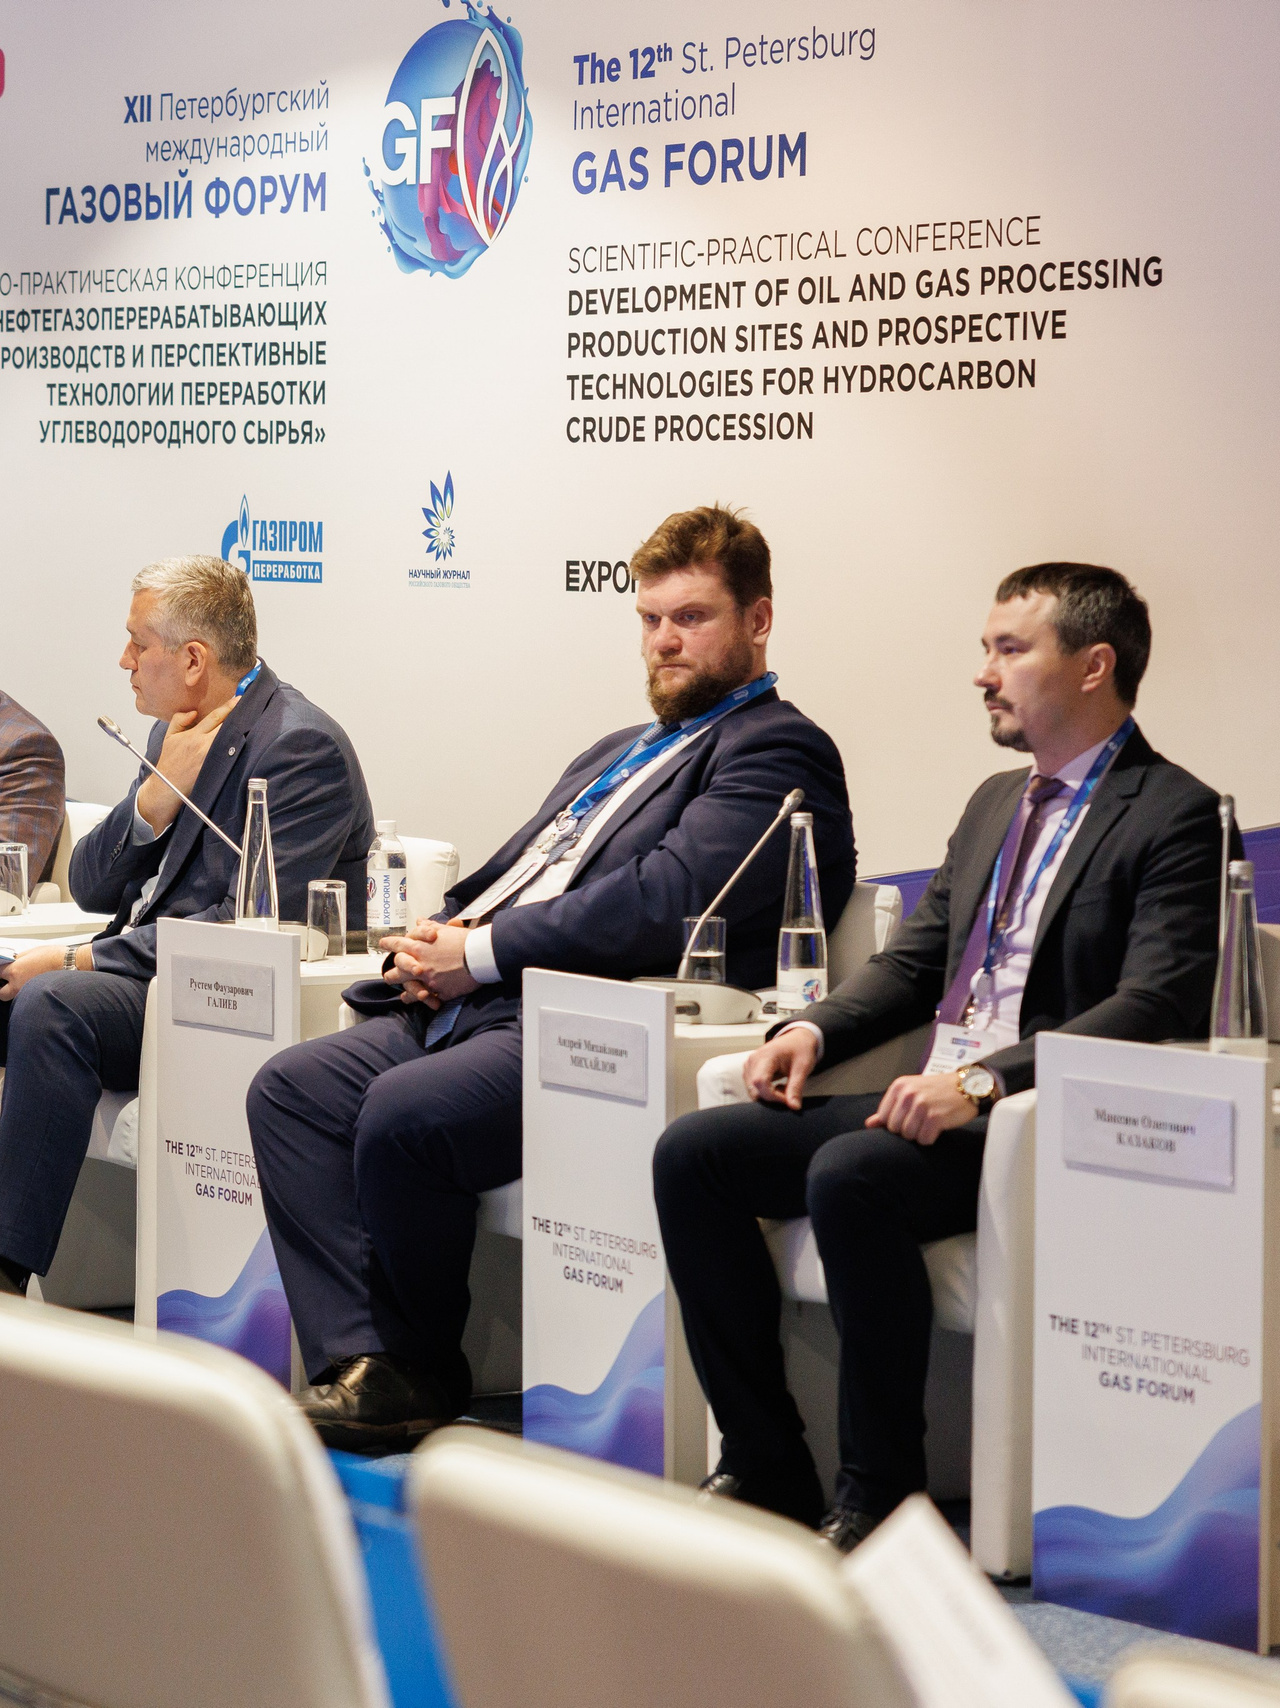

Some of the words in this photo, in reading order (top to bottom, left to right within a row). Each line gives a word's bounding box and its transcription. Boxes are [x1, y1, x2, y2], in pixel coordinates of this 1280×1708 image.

[573, 53, 622, 86] The
[630, 44, 672, 80] 12th
[682, 40, 715, 75] St.
[725, 25, 877, 70] Petersburg
[123, 94, 152, 124] XII
[159, 80, 330, 124] Петербургский
[573, 82, 736, 131] International
[145, 122, 329, 165] международный
[572, 145, 649, 195] GAS
[664, 132, 808, 189] FORUM
[45, 171, 193, 226] ГАЗОВЫЙ
[204, 171, 327, 219] ФОРУМ
[569, 231, 846, 274] SCIENTIFIC-PRACTICAL
[858, 215, 1042, 256] CONFERENCE
[175, 261, 327, 293] КОНФЕРЕНЦИЯ
[568, 283, 746, 316] DEVELOPMENT
[754, 278, 789, 308] OF
[798, 276, 841, 306] OIL
[848, 271, 906, 302] AND
[916, 267, 970, 298] GAS
[980, 256, 1163, 294] PROCESSING
[567, 325, 725, 359] PRODUCTION
[735, 320, 803, 352] SITES
[812, 318, 868, 350] AND
[879, 310, 1067, 347] PROSPECTIVE
[133, 344, 145, 368] И
[151, 341, 327, 367] ПЕРСПЕКТИВНЫЕ
[46, 382, 174, 407] ТЕХНОЛОГИИ
[181, 380, 327, 406] ПЕРЕРАБОТКИ
[566, 368, 754, 402] TECHNOLOGIES
[763, 365, 814, 397] FOR
[823, 358, 1036, 394] HYDROCARBON
[39, 420, 236, 448] УГЛЕВОДОРОДНОГО
[243, 419, 326, 444] СЫРЬЯ»
[566, 413, 644, 444] CRUDE
[654, 410, 814, 442] PROCESSION
[252, 519, 323, 553] ГАЗПРОМ
[254, 563, 320, 580] ПЕРЕРАБОТКА
[408, 567, 441, 579] НАУЧНЫЙ
[442, 569, 471, 580] ЖУРНАЛ
[565, 560, 640, 593] EXPO
[383, 874, 391, 925] EXPOFORUM
[189, 977, 213, 991] Рустем
[213, 981, 254, 997] Фаузарович
[207, 996, 238, 1011] ГАЛИЕВ
[165, 1139, 183, 1156] THE
[205, 1147, 218, 1162] ST.
[220, 1149, 258, 1170] PETERS
[195, 1182, 216, 1199] GAS
[217, 1186, 253, 1206] FORUM
[531, 1215, 551, 1234] THE
[573, 1225, 588, 1243] ST.
[589, 1229, 657, 1259] PETERSBURG
[552, 1241, 634, 1275] INTERNATIONAL
[563, 1265, 584, 1283] GAS
[586, 1270, 624, 1294] FORUM
[1048, 1313, 1080, 1335] THE
[1115, 1325, 1137, 1347] ST.
[1141, 1330, 1251, 1368] PETERSBURG
[1081, 1344, 1212, 1384] INTERNATIONAL
[1099, 1370, 1133, 1392] GAS
[1135, 1377, 1196, 1404] FORUM
